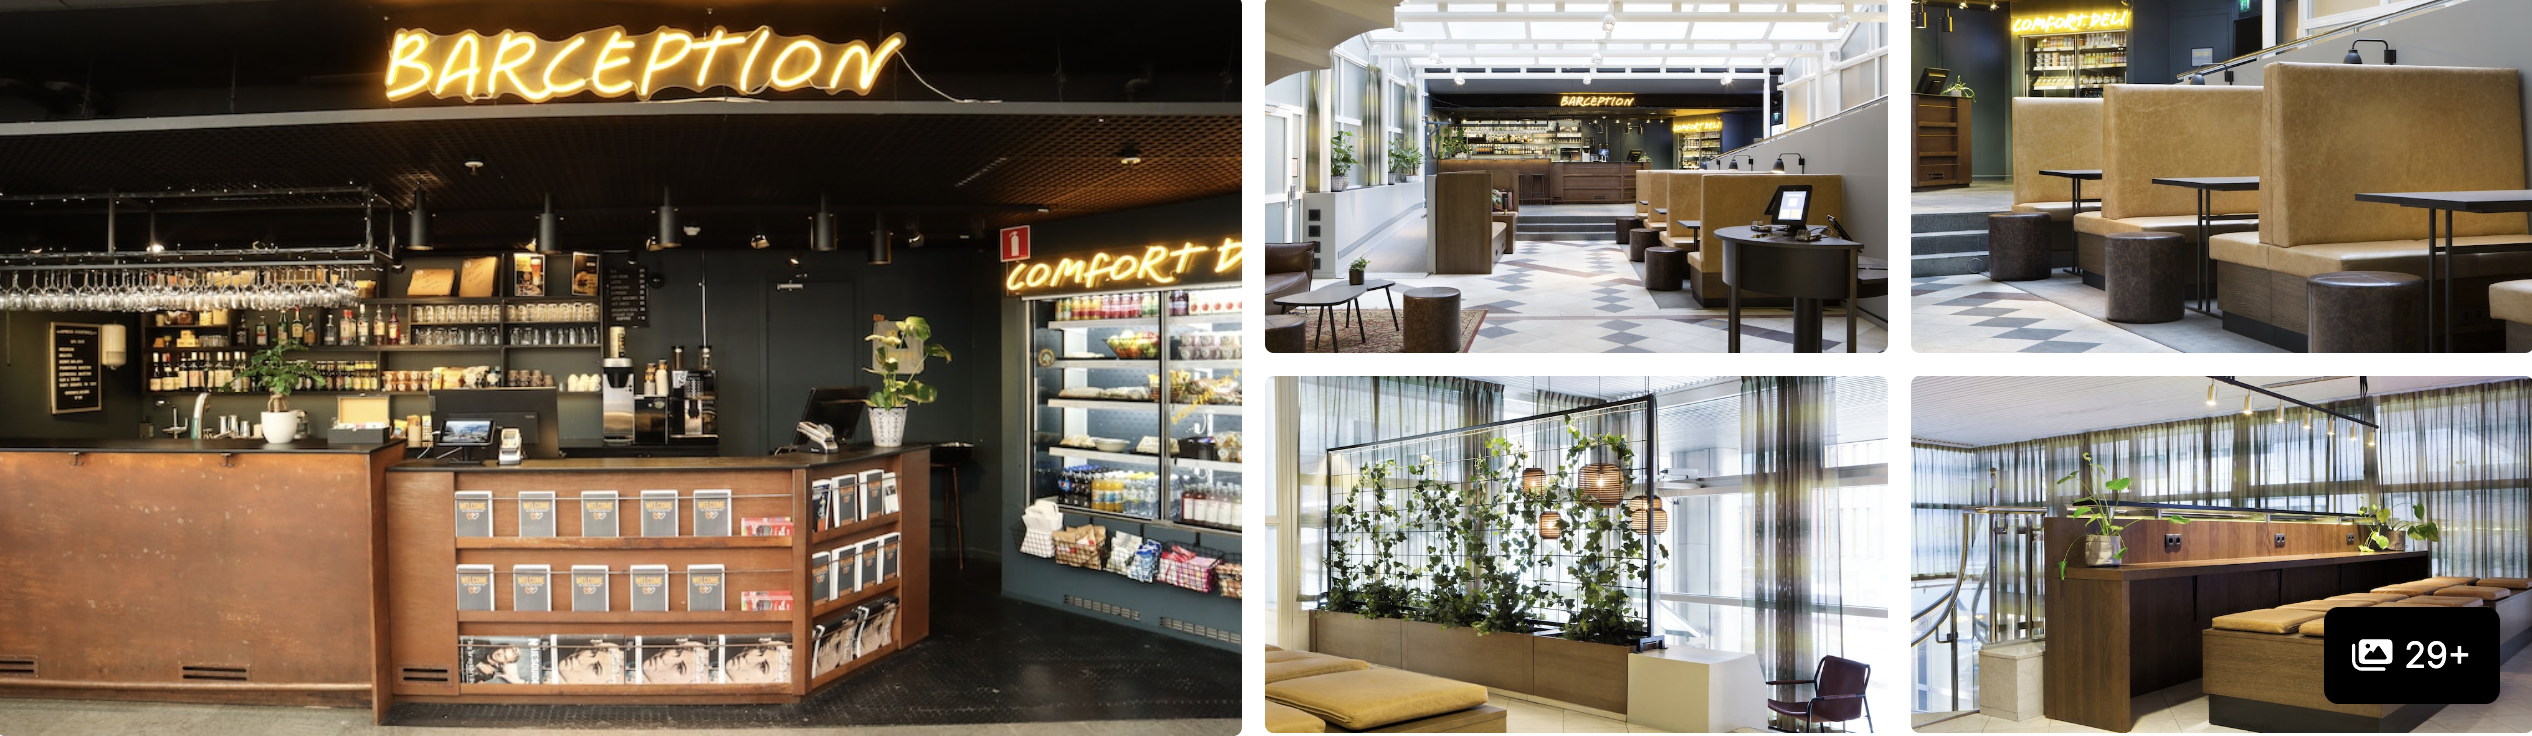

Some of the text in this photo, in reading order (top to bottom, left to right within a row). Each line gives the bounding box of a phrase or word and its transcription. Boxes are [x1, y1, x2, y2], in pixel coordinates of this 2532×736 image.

[2012, 10, 2128, 33] COMFORT DELI
[385, 26, 902, 100] BARCEPTION
[1560, 95, 1635, 107] BARCEPTION
[1673, 121, 1721, 132] COMFORT DELI
[1006, 241, 1209, 291] COMFORT
[459, 501, 487, 510] WELCOME
[522, 501, 550, 510] WELCOME
[585, 501, 614, 510] WELCOME
[645, 501, 673, 510] WELCOME
[698, 501, 726, 510] WELCOME
[460, 576, 488, 585] WELCOME
[517, 576, 545, 585] WELCOME
[575, 576, 603, 585] WELCOME
[635, 576, 663, 585] WELCOME
[692, 576, 720, 585] WELCOME
